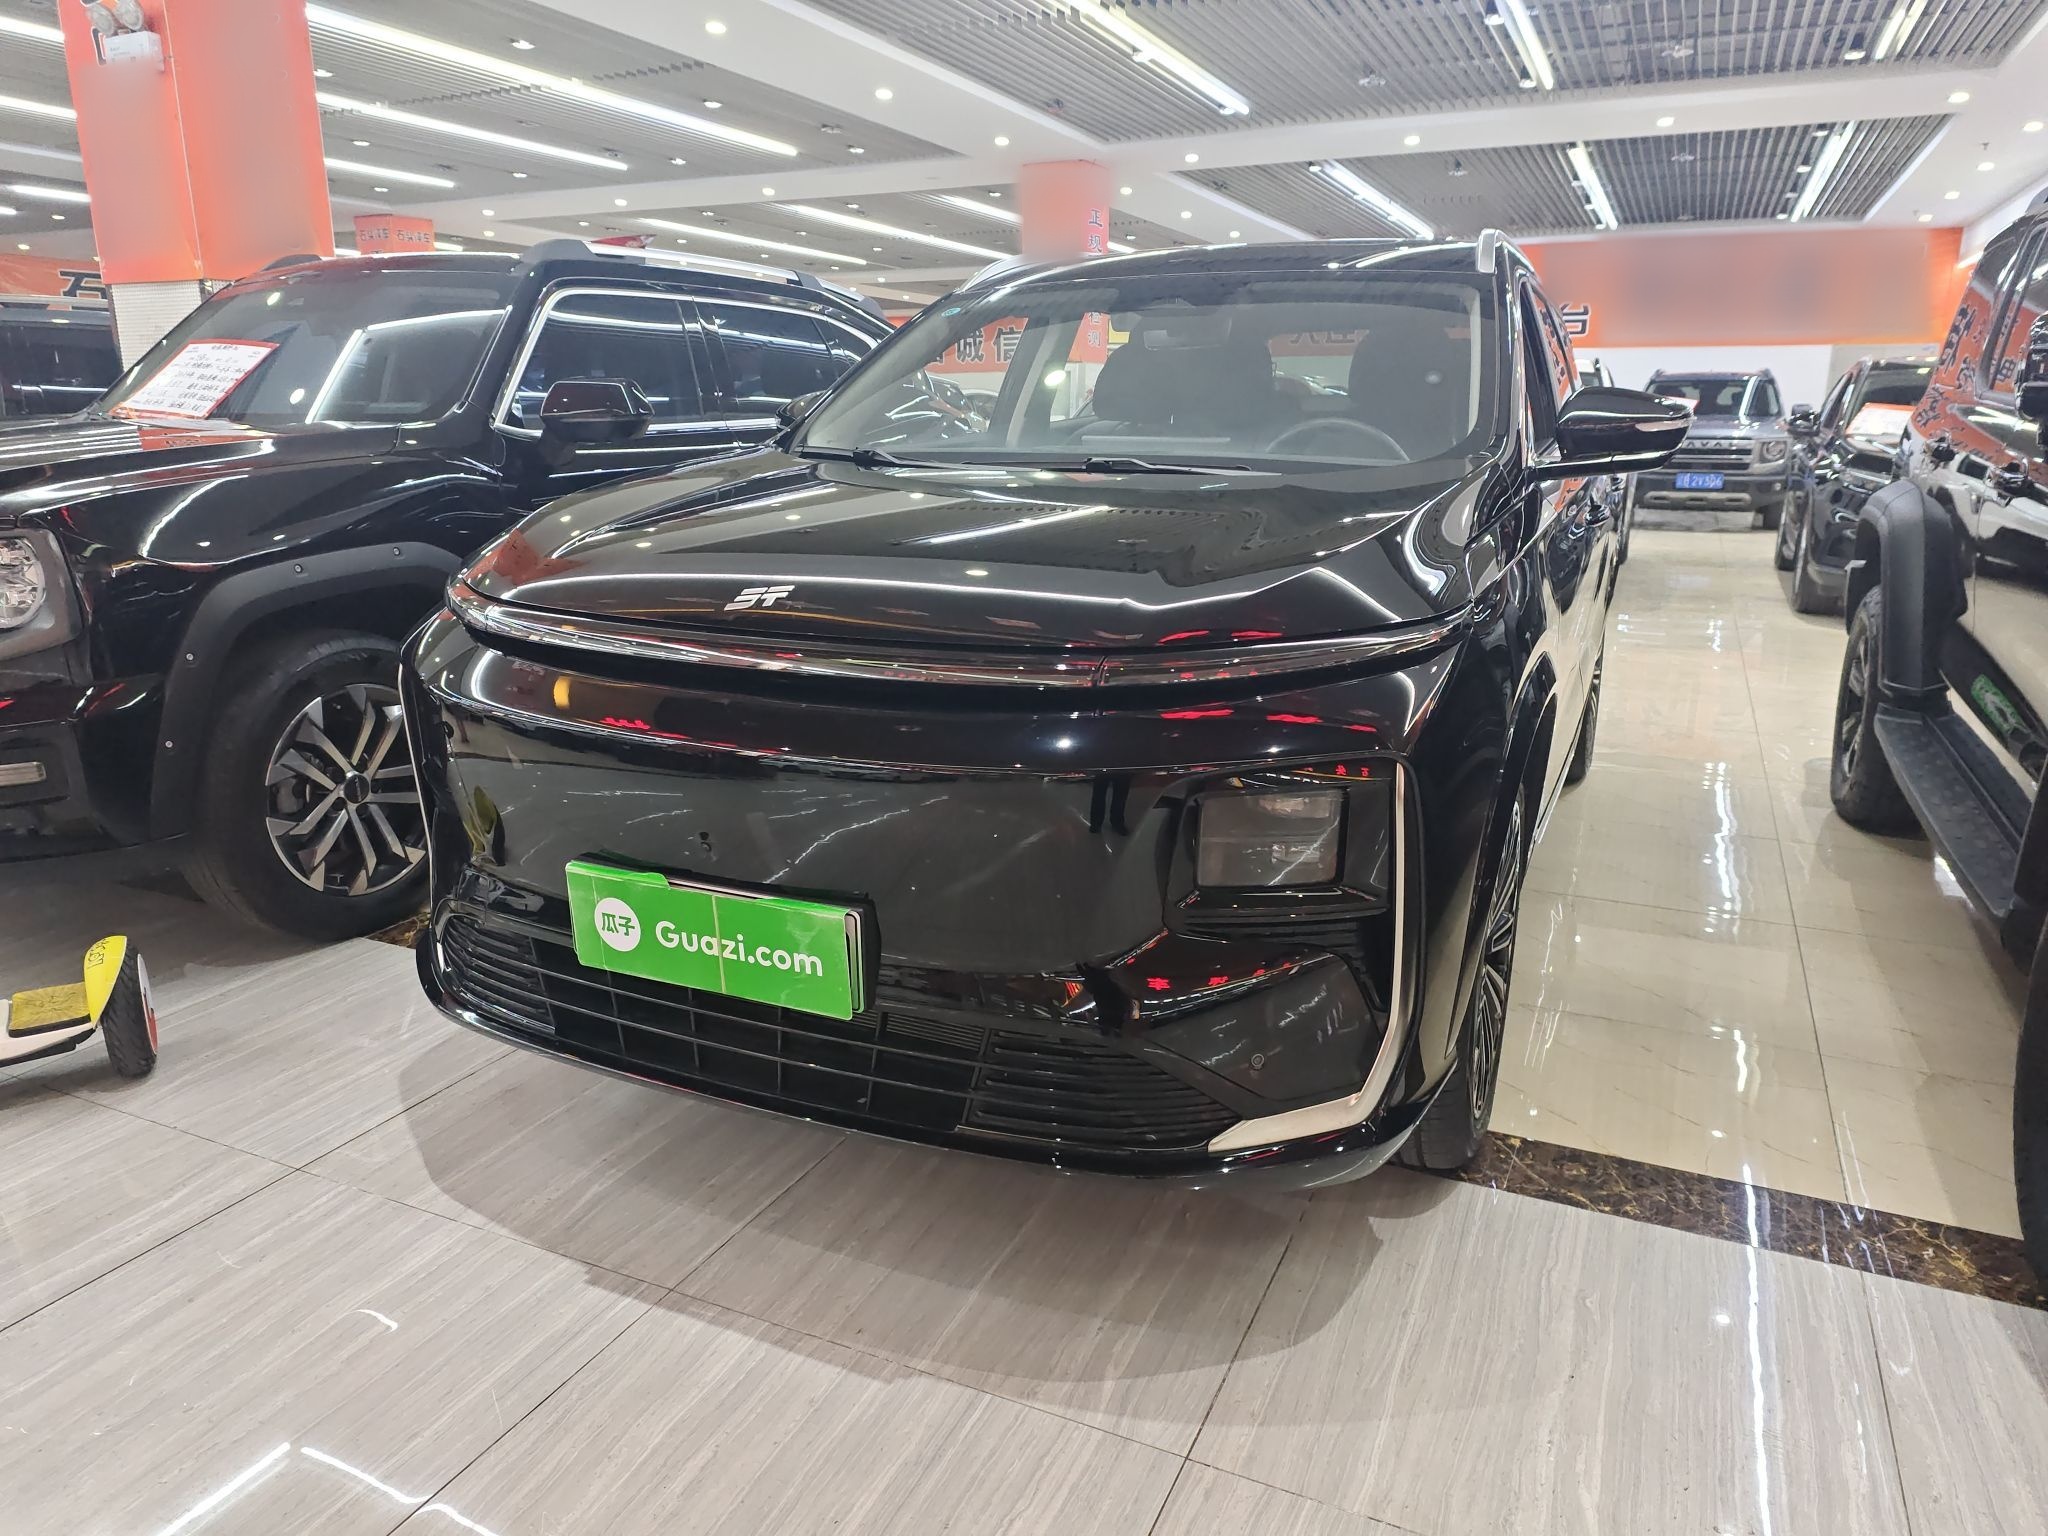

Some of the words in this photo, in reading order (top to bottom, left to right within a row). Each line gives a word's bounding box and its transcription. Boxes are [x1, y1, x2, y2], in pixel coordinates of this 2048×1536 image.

[935, 326, 1022, 363] 诚信
[601, 911, 636, 937] 瓜子
[655, 920, 823, 977] Guazi.com
